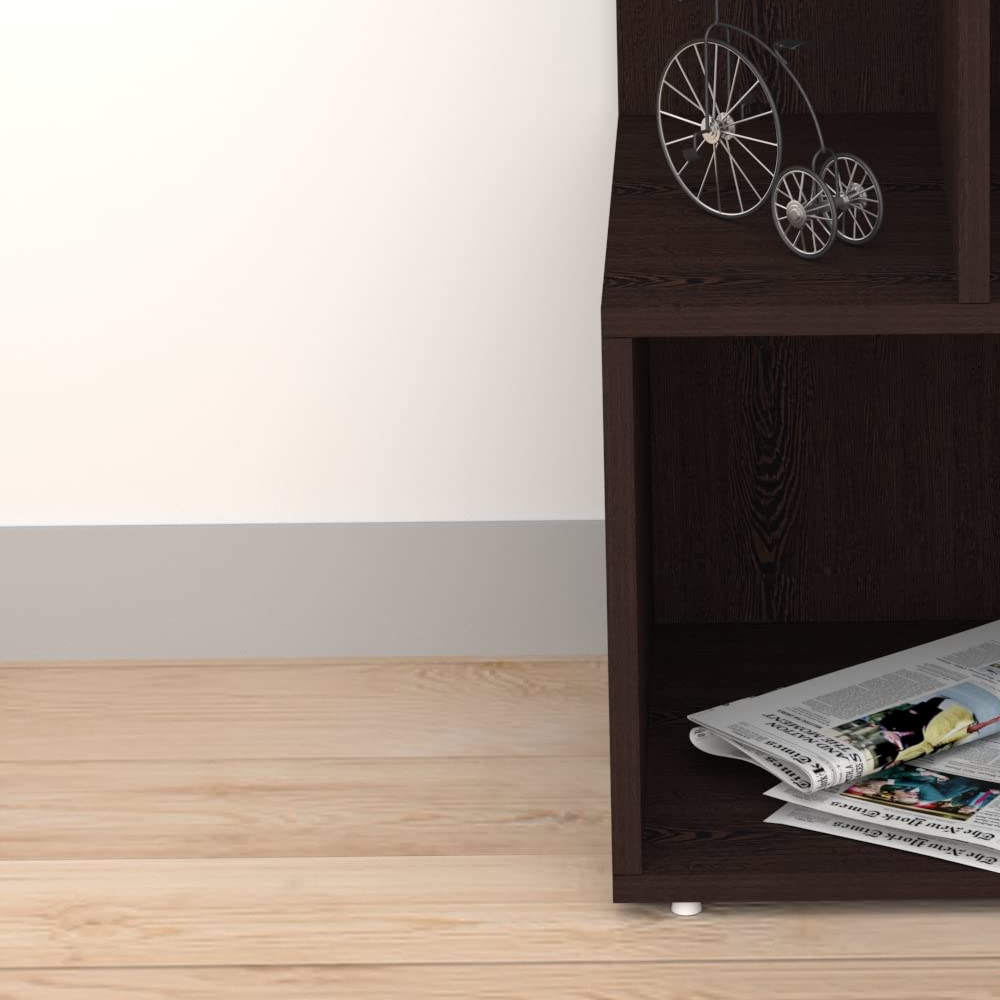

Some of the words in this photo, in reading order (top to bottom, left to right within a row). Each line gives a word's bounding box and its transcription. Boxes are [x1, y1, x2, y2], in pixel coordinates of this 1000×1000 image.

[762, 713, 824, 740] MOMENT
[766, 722, 815, 745] NATION
[814, 741, 849, 760] AND
[820, 736, 851, 752] THE
[764, 741, 812, 765] Times
[764, 756, 811, 789] Times
[829, 800, 880, 818] Times
[880, 812, 927, 828] York
[831, 821, 883, 838] Times
[925, 821, 963, 836] New
[964, 827, 996, 841] The
[885, 832, 931, 848] York
[928, 842, 965, 857] New
[966, 850, 998, 865] The
